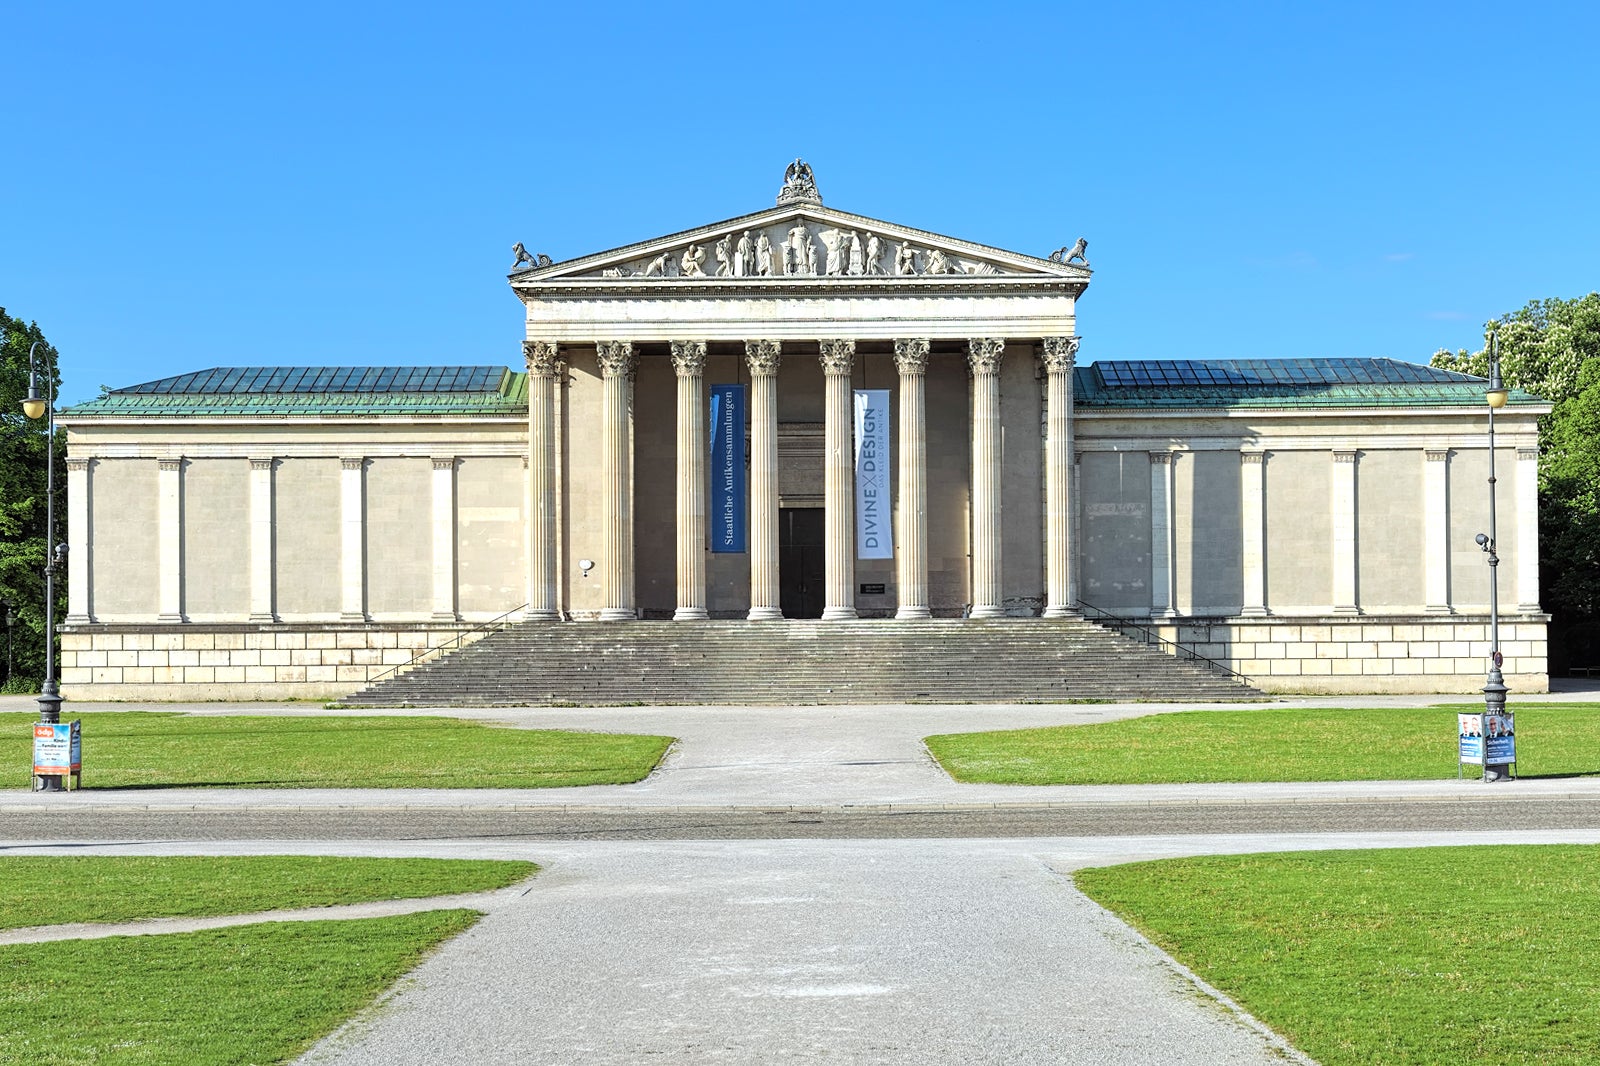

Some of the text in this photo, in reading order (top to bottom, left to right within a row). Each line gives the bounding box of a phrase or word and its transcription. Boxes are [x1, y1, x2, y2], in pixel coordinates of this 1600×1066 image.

[723, 391, 734, 545] Staatliche Antikensammlungen
[863, 408, 876, 472] DESIGN
[863, 489, 879, 548] DIVINE
